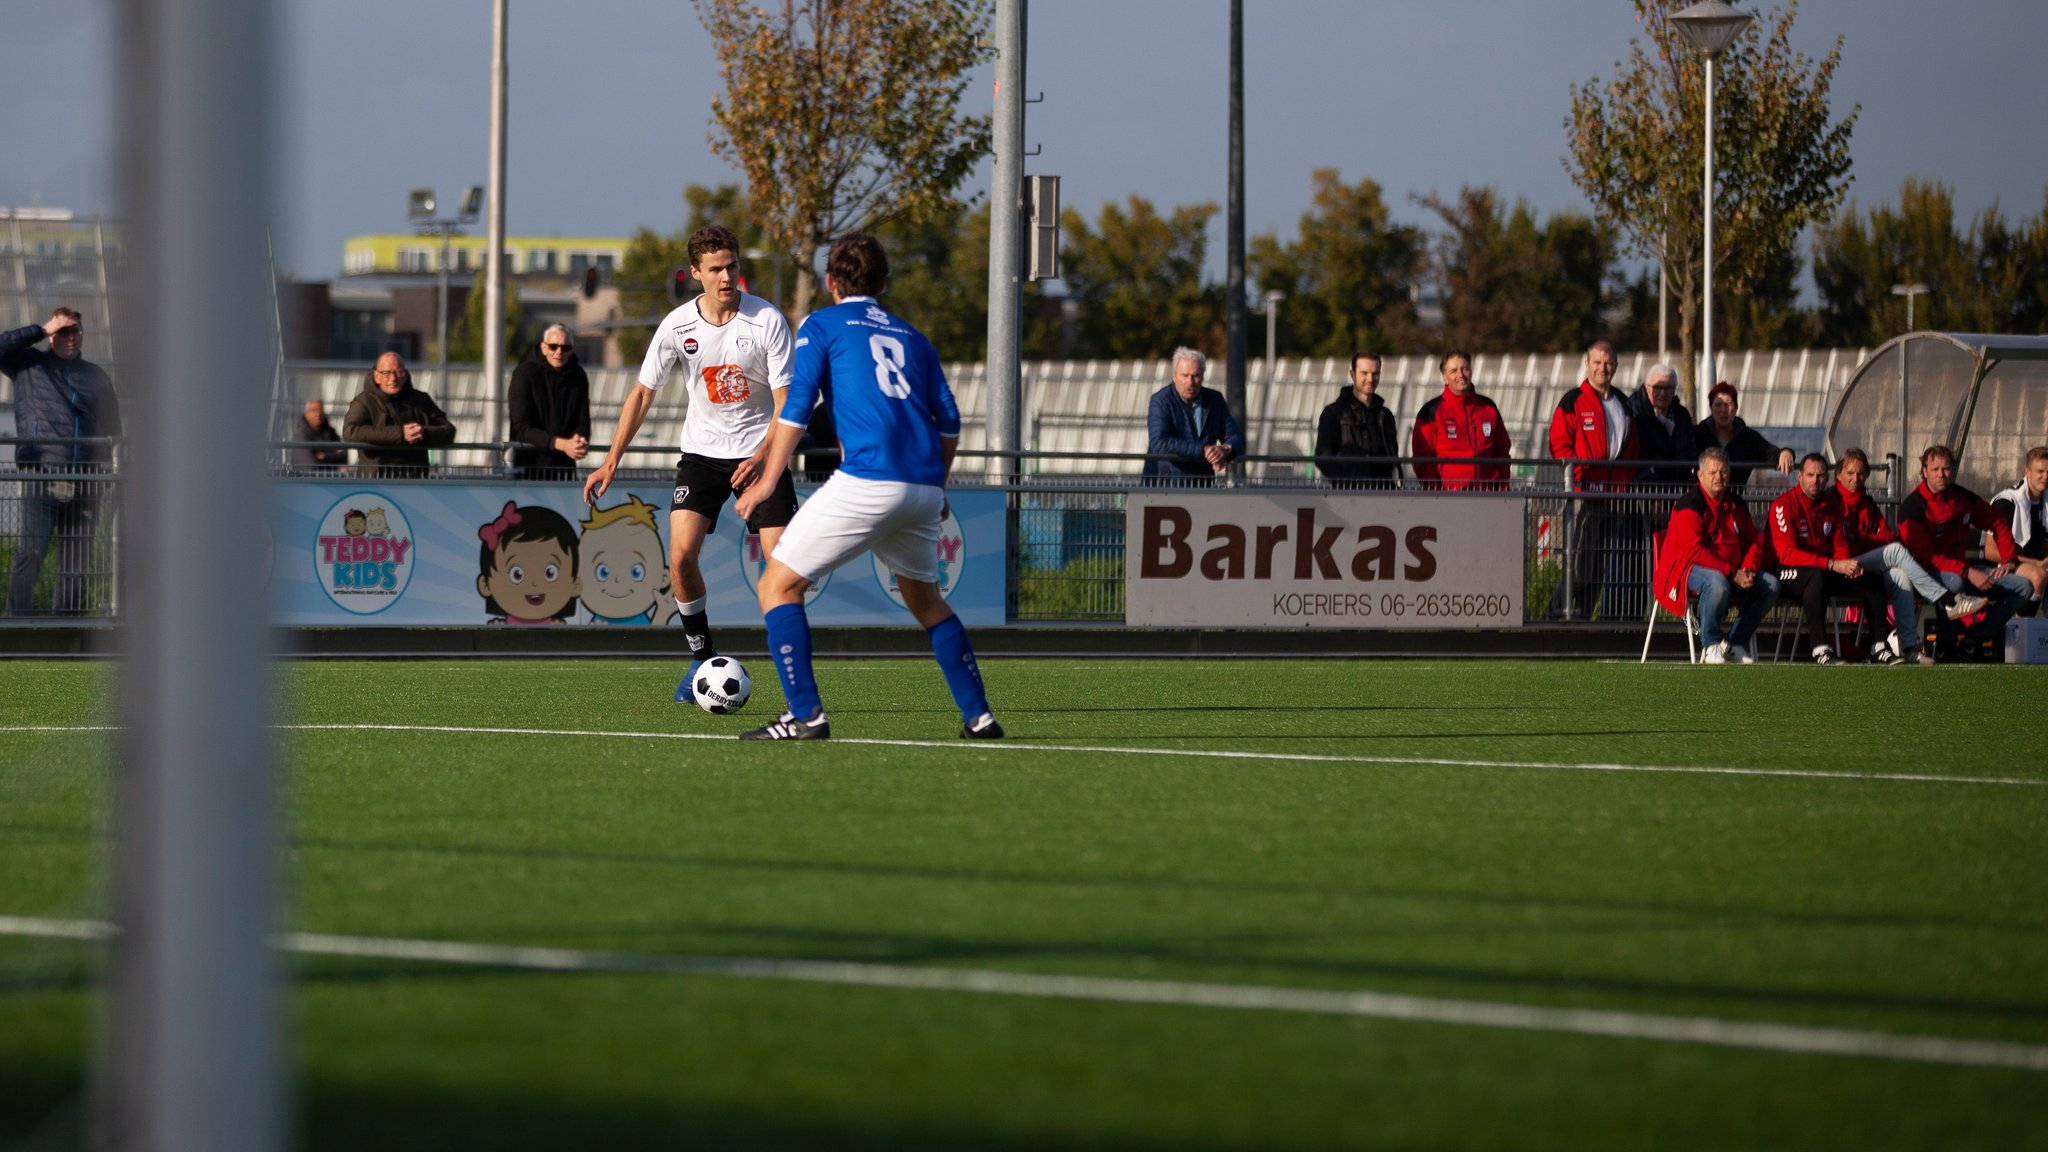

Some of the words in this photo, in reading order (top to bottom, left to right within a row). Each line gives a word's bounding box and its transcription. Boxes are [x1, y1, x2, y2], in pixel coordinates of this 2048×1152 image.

[868, 333, 911, 400] 8
[319, 536, 411, 564] TEDDY
[1140, 506, 1438, 582] Barkas
[333, 561, 397, 590] KIDS
[1273, 593, 1372, 617] KOERIERS
[1380, 593, 1511, 617] 06-26356260
